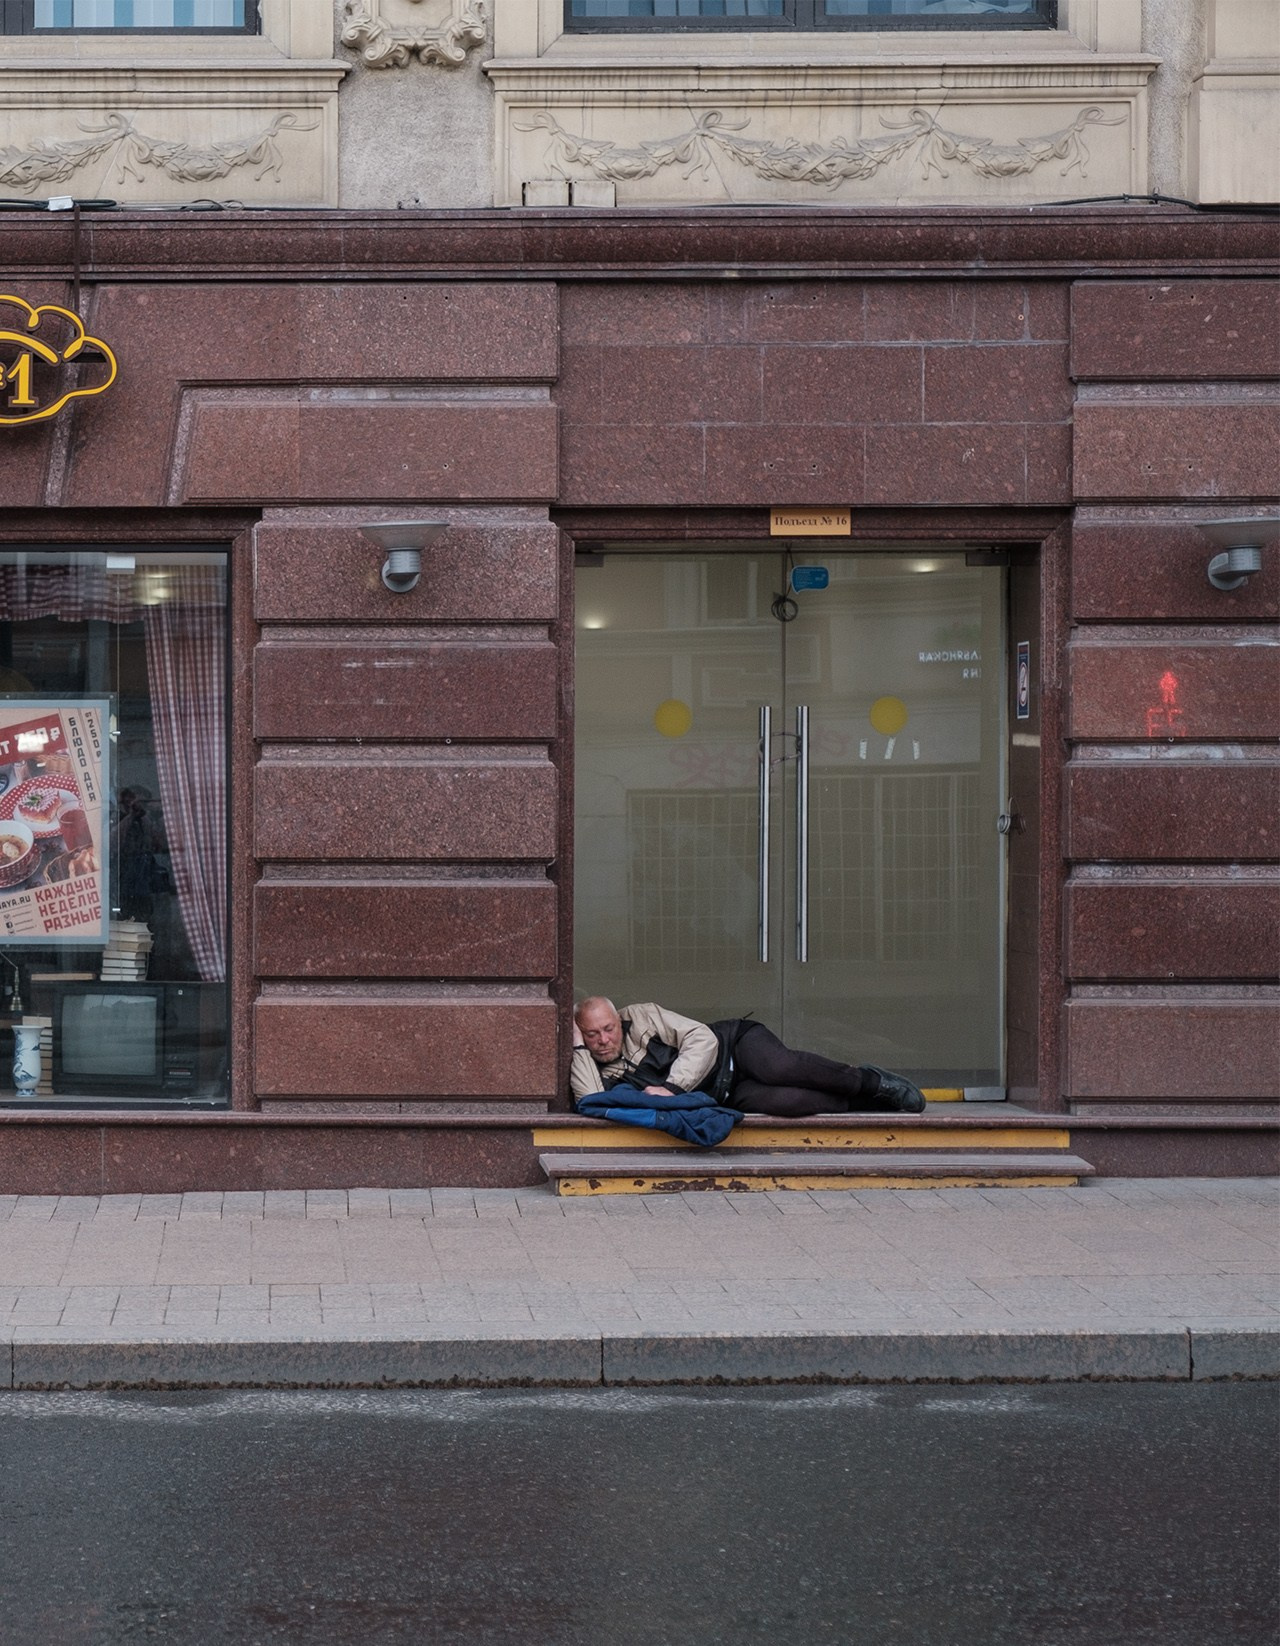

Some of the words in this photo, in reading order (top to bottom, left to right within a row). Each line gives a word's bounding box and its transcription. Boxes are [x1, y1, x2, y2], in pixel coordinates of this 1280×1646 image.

[775, 516, 817, 526] Подъезд
[836, 516, 847, 526] 16
[68, 717, 87, 767] БЛЮДО
[83, 772, 97, 801] ДНЯ
[34, 876, 97, 904] КАЖДУЮ
[38, 891, 100, 918] НЕДЕЛЮ
[43, 906, 101, 933] РАЗНЫЕ
